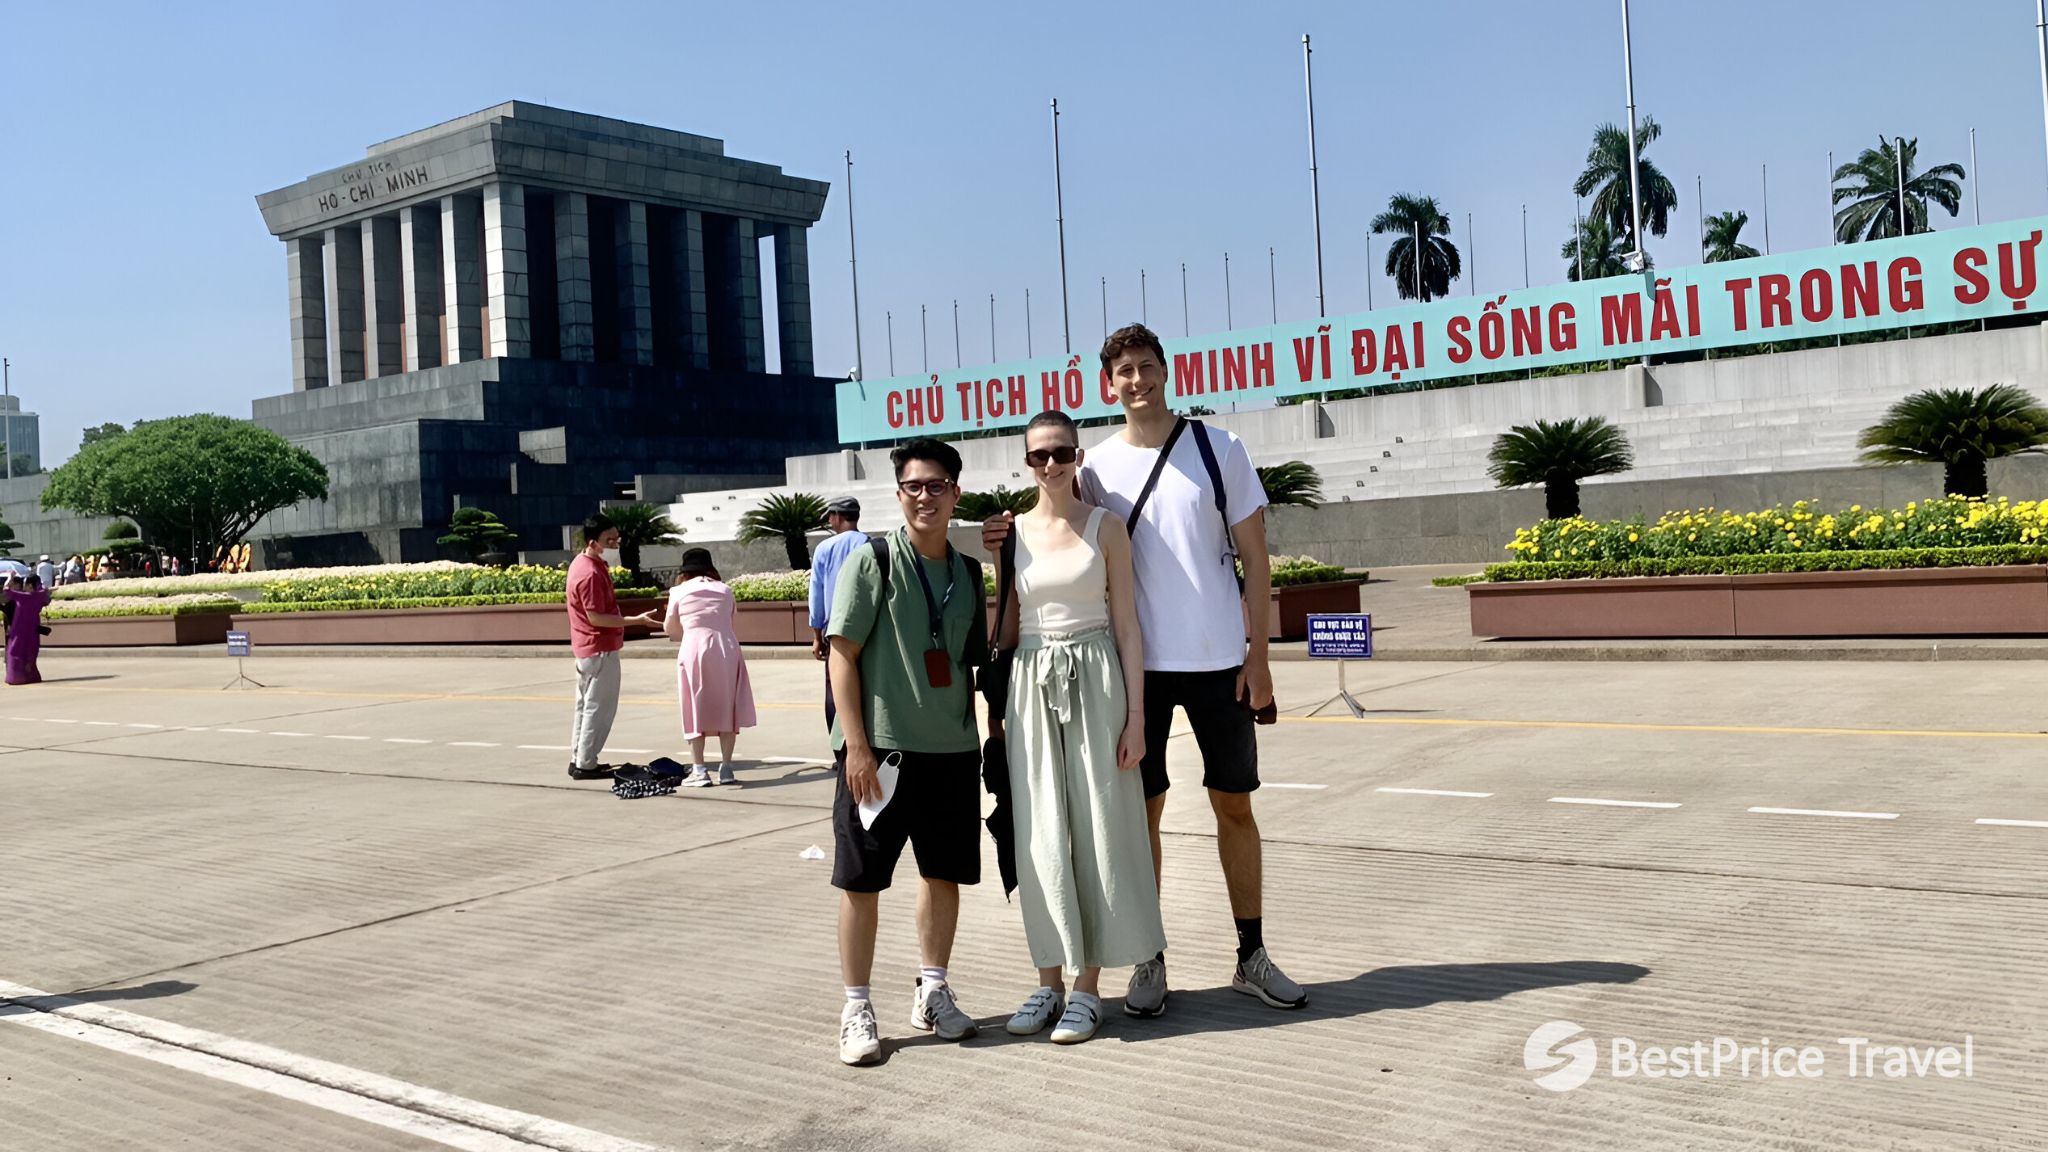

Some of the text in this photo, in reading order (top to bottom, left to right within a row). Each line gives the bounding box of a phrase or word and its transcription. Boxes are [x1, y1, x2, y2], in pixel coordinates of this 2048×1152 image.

[887, 374, 944, 429] CHỦ
[957, 375, 1027, 428] TỊCH
[1041, 354, 1083, 413] HỒ
[1174, 342, 1275, 398] MINH
[1292, 323, 1332, 383] VĨ
[1351, 320, 1426, 381] ĐẠI
[1446, 294, 1578, 365] SỐNG
[1600, 277, 1701, 347] MÃI
[1725, 256, 1925, 332] TRONG
[1952, 229, 2044, 312] SỰ
